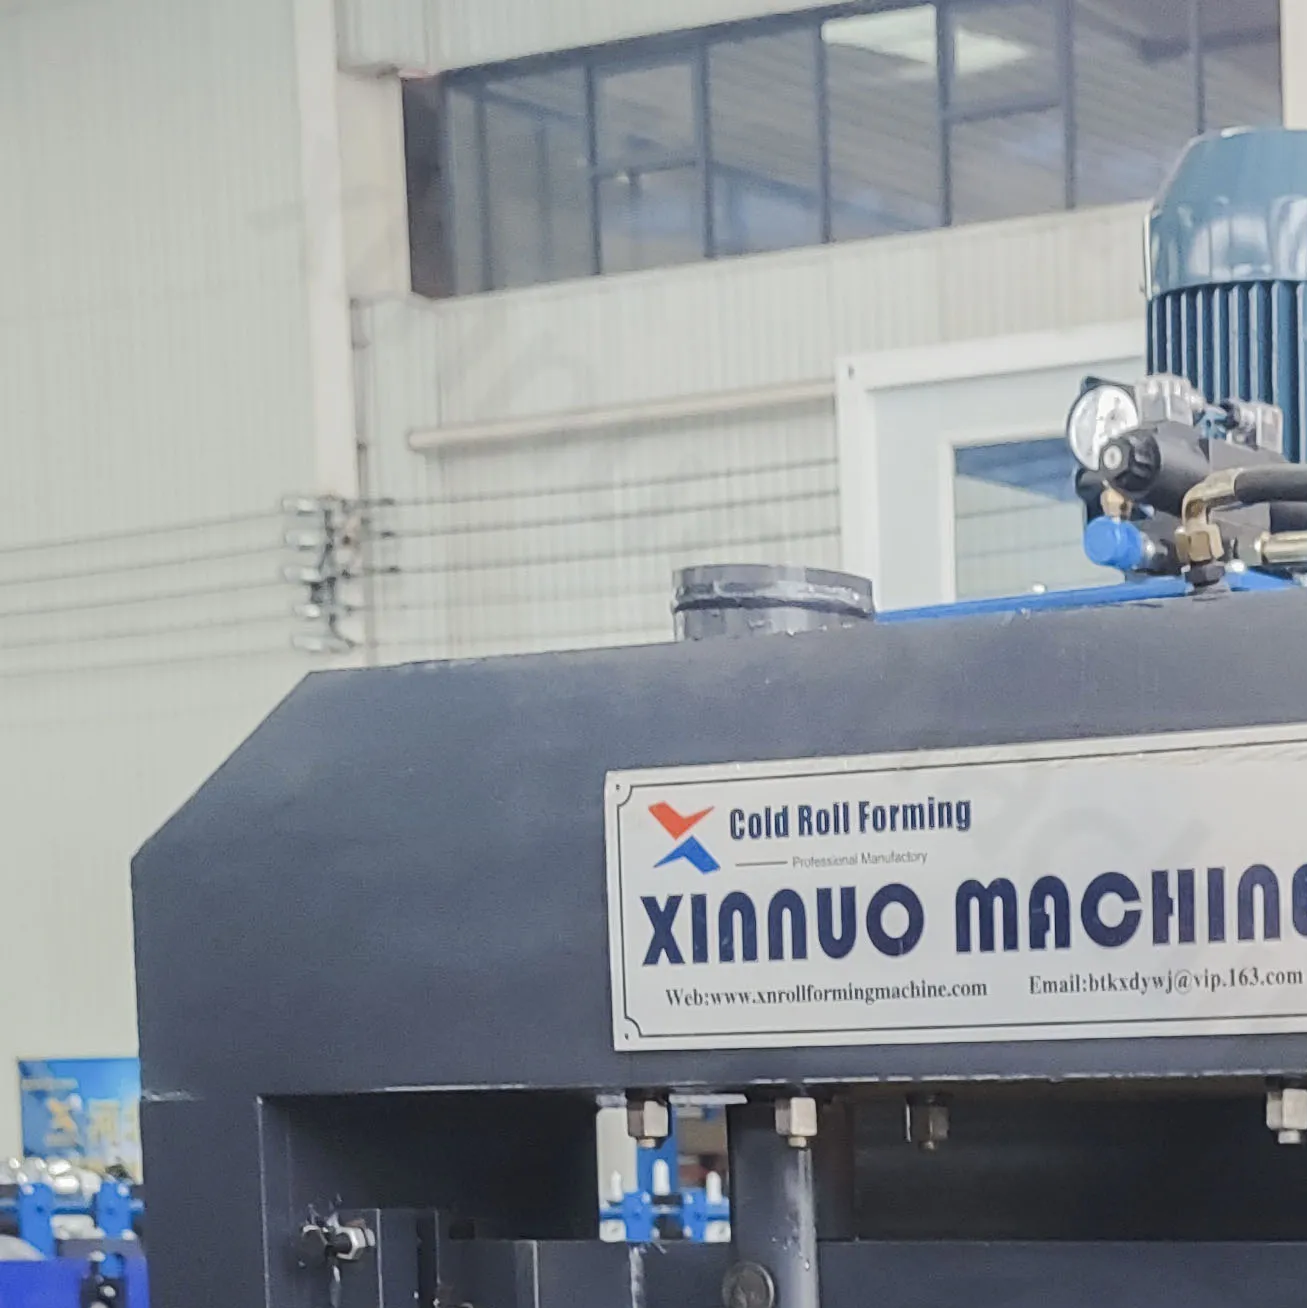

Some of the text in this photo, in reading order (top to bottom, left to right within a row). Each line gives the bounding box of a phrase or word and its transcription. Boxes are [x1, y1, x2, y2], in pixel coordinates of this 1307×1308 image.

[729, 805, 790, 841] Cold
[797, 800, 850, 837] Roll
[857, 796, 972, 833] Forming
[792, 850, 929, 868] Professional Manufactory
[639, 880, 927, 967] XINNUO
[664, 965, 1305, 1007] Web:www.xnrollformingmachine.com Email:btkxdywj@vip.163.com
